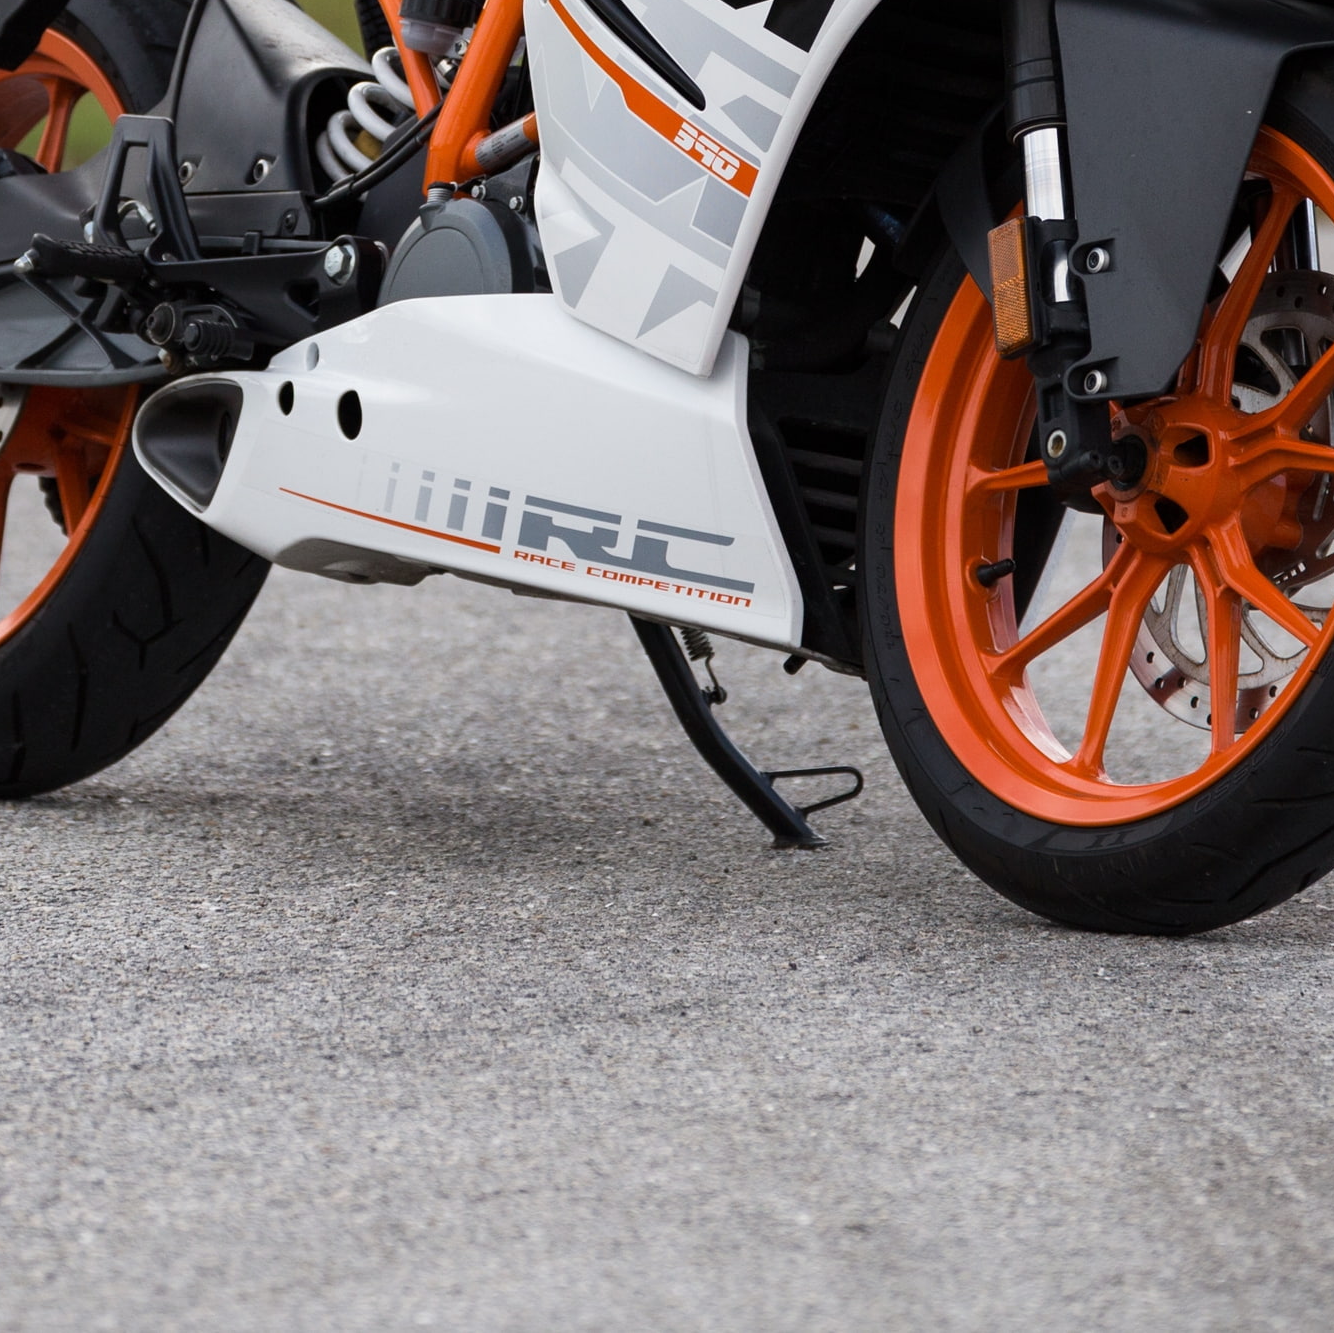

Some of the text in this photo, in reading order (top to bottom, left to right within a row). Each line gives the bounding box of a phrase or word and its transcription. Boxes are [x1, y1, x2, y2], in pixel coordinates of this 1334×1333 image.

[673, 121, 741, 182] 390
[517, 494, 756, 595] RC
[513, 550, 753, 608] RACE COMPETITION
